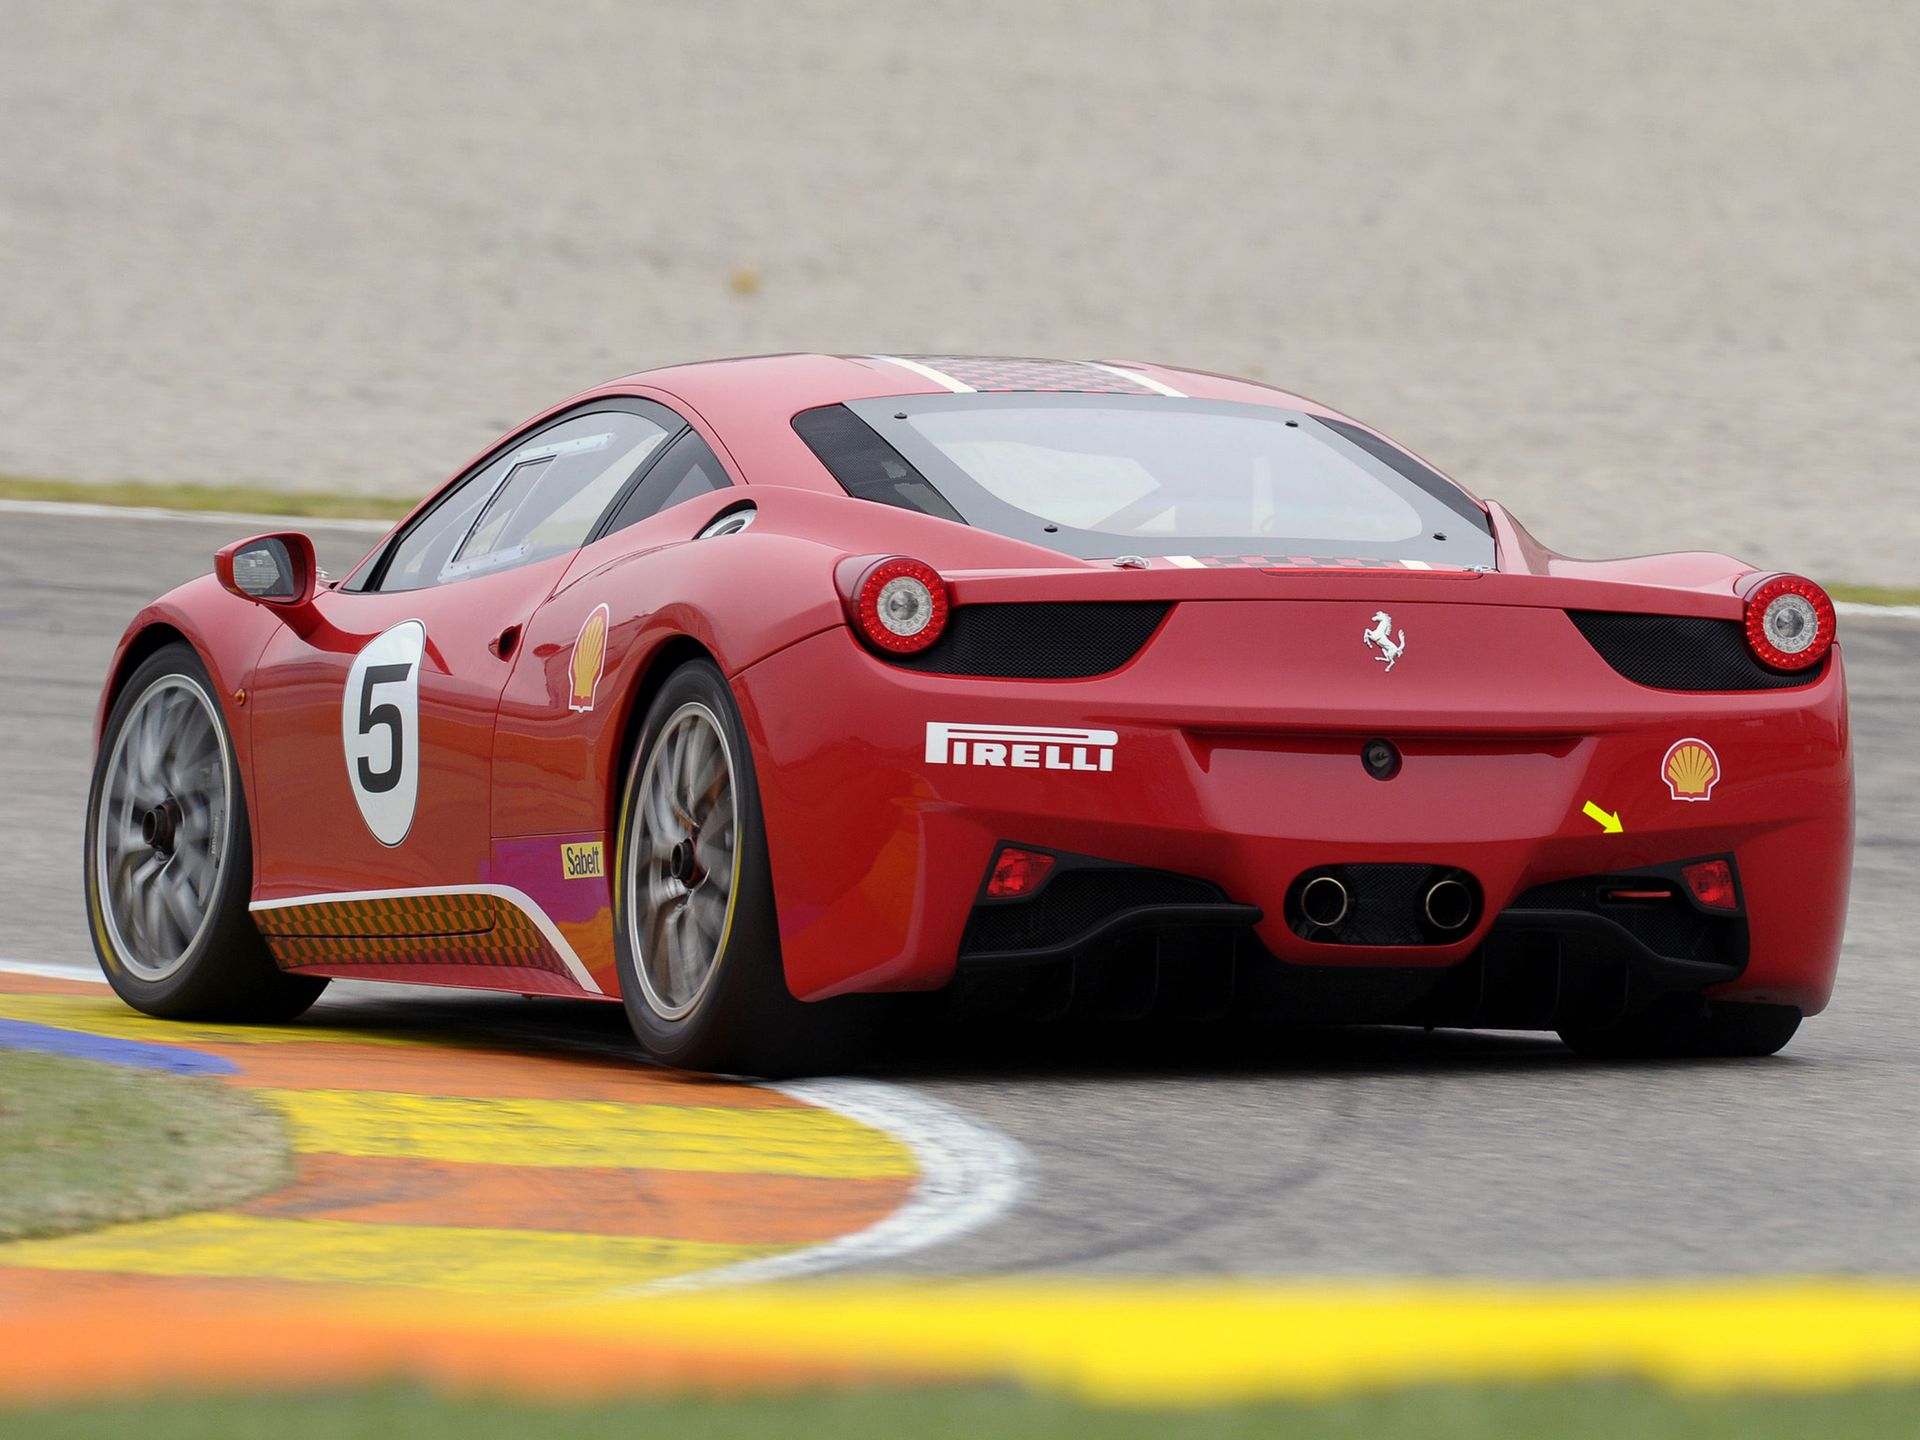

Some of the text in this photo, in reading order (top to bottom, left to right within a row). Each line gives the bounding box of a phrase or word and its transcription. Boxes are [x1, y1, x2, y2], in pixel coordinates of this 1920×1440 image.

[357, 663, 413, 793] 5
[925, 722, 1119, 772] PIRELLI
[566, 846, 600, 875] Sabelt
